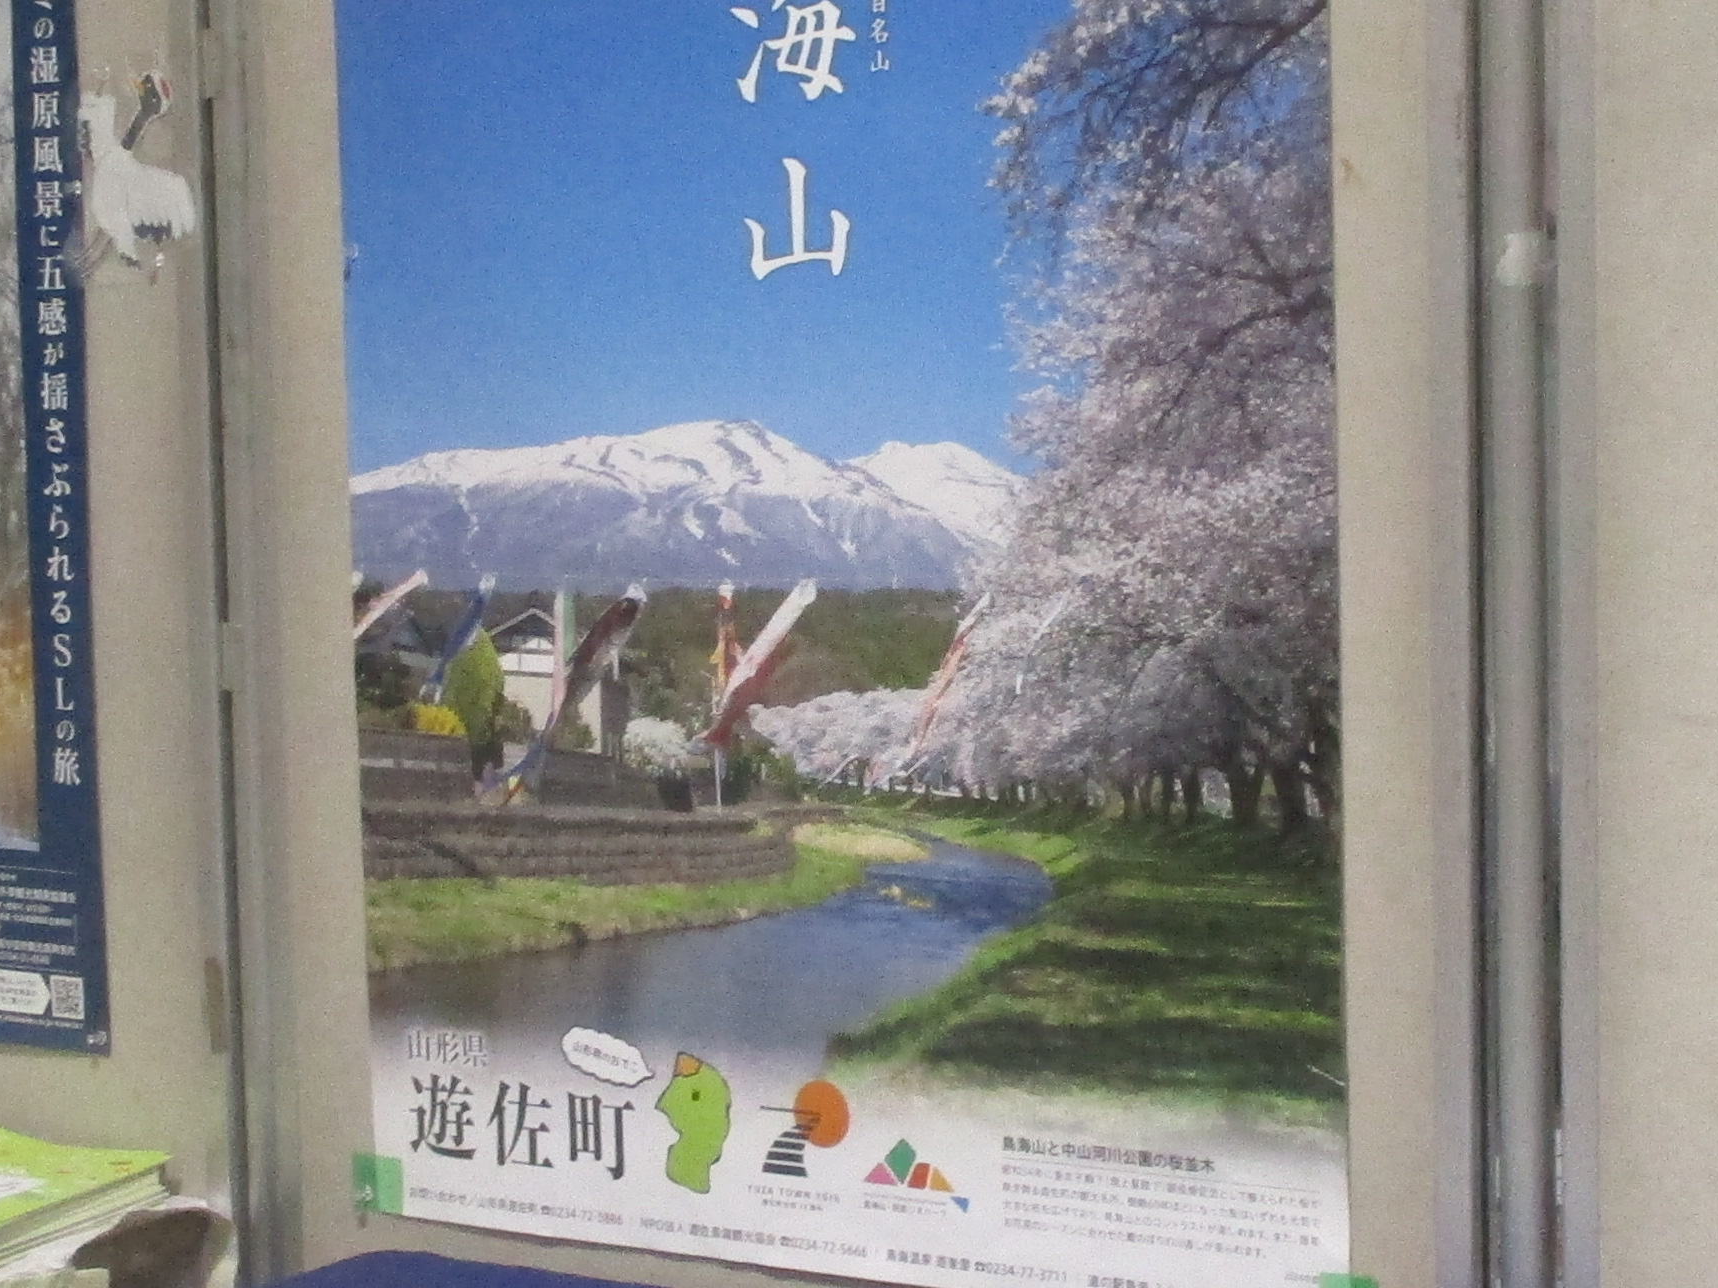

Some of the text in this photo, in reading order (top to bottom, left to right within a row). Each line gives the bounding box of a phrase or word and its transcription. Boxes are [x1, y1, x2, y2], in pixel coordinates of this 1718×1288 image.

[406, 1028, 489, 1068] 山形県
[409, 1072, 635, 1181] 遊佐町
